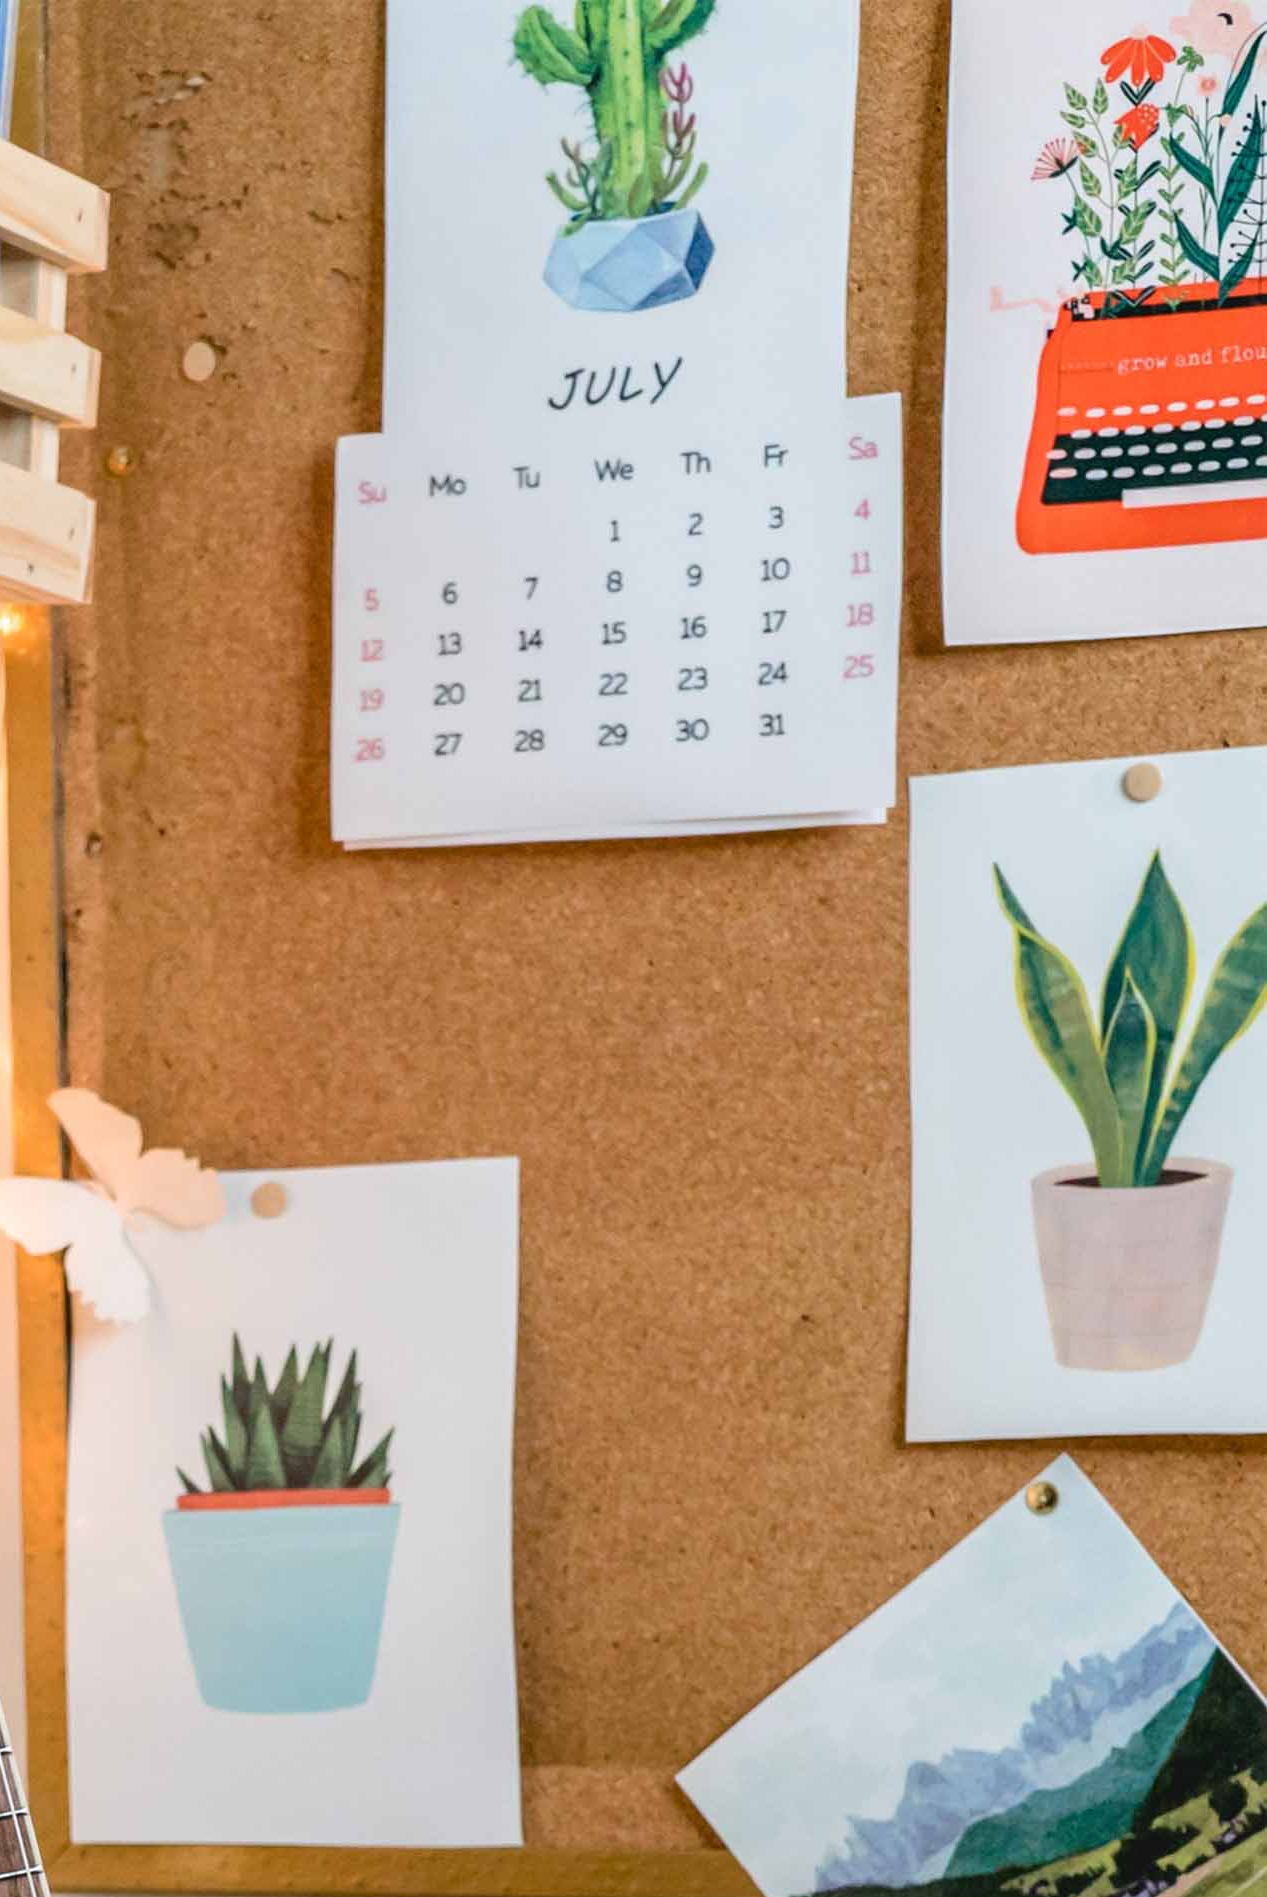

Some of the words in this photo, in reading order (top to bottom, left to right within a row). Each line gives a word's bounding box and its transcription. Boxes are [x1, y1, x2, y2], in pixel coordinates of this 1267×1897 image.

[547, 356, 683, 411] JULY
[1117, 356, 1168, 376] grow
[1174, 347, 1215, 368] and
[357, 480, 388, 505] Su
[429, 474, 467, 497] Mo
[512, 465, 541, 489] Tu
[594, 459, 635, 482] We
[680, 450, 712, 475] Th
[763, 443, 789, 468] Fr
[847, 435, 879, 461] Sa
[610, 519, 621, 543] 1
[687, 512, 704, 537] 2
[768, 505, 785, 530] 3
[853, 498, 872, 521] 4
[364, 587, 380, 613] 5
[441, 581, 459, 606] 6
[524, 576, 539, 601] 7
[605, 569, 624, 594] 8
[686, 563, 703, 588] 9
[760, 556, 791, 583] 10
[850, 550, 873, 577] 11
[359, 638, 384, 663] 12
[437, 631, 463, 657] 13
[518, 629, 544, 652] 14
[601, 620, 627, 646] 15
[680, 615, 708, 641] 16
[762, 609, 788, 635] 17
[845, 602, 875, 629] 18
[359, 687, 386, 713] 19
[432, 681, 466, 707] 20
[517, 678, 543, 703] 21
[597, 671, 629, 697] 22
[677, 666, 709, 692] 23
[757, 661, 789, 687] 24
[842, 653, 876, 680] 25
[353, 737, 386, 763] 26
[433, 732, 463, 757] 27
[513, 728, 545, 753] 28
[597, 722, 629, 748] 29
[675, 717, 710, 743] 30
[759, 713, 786, 737] 31
